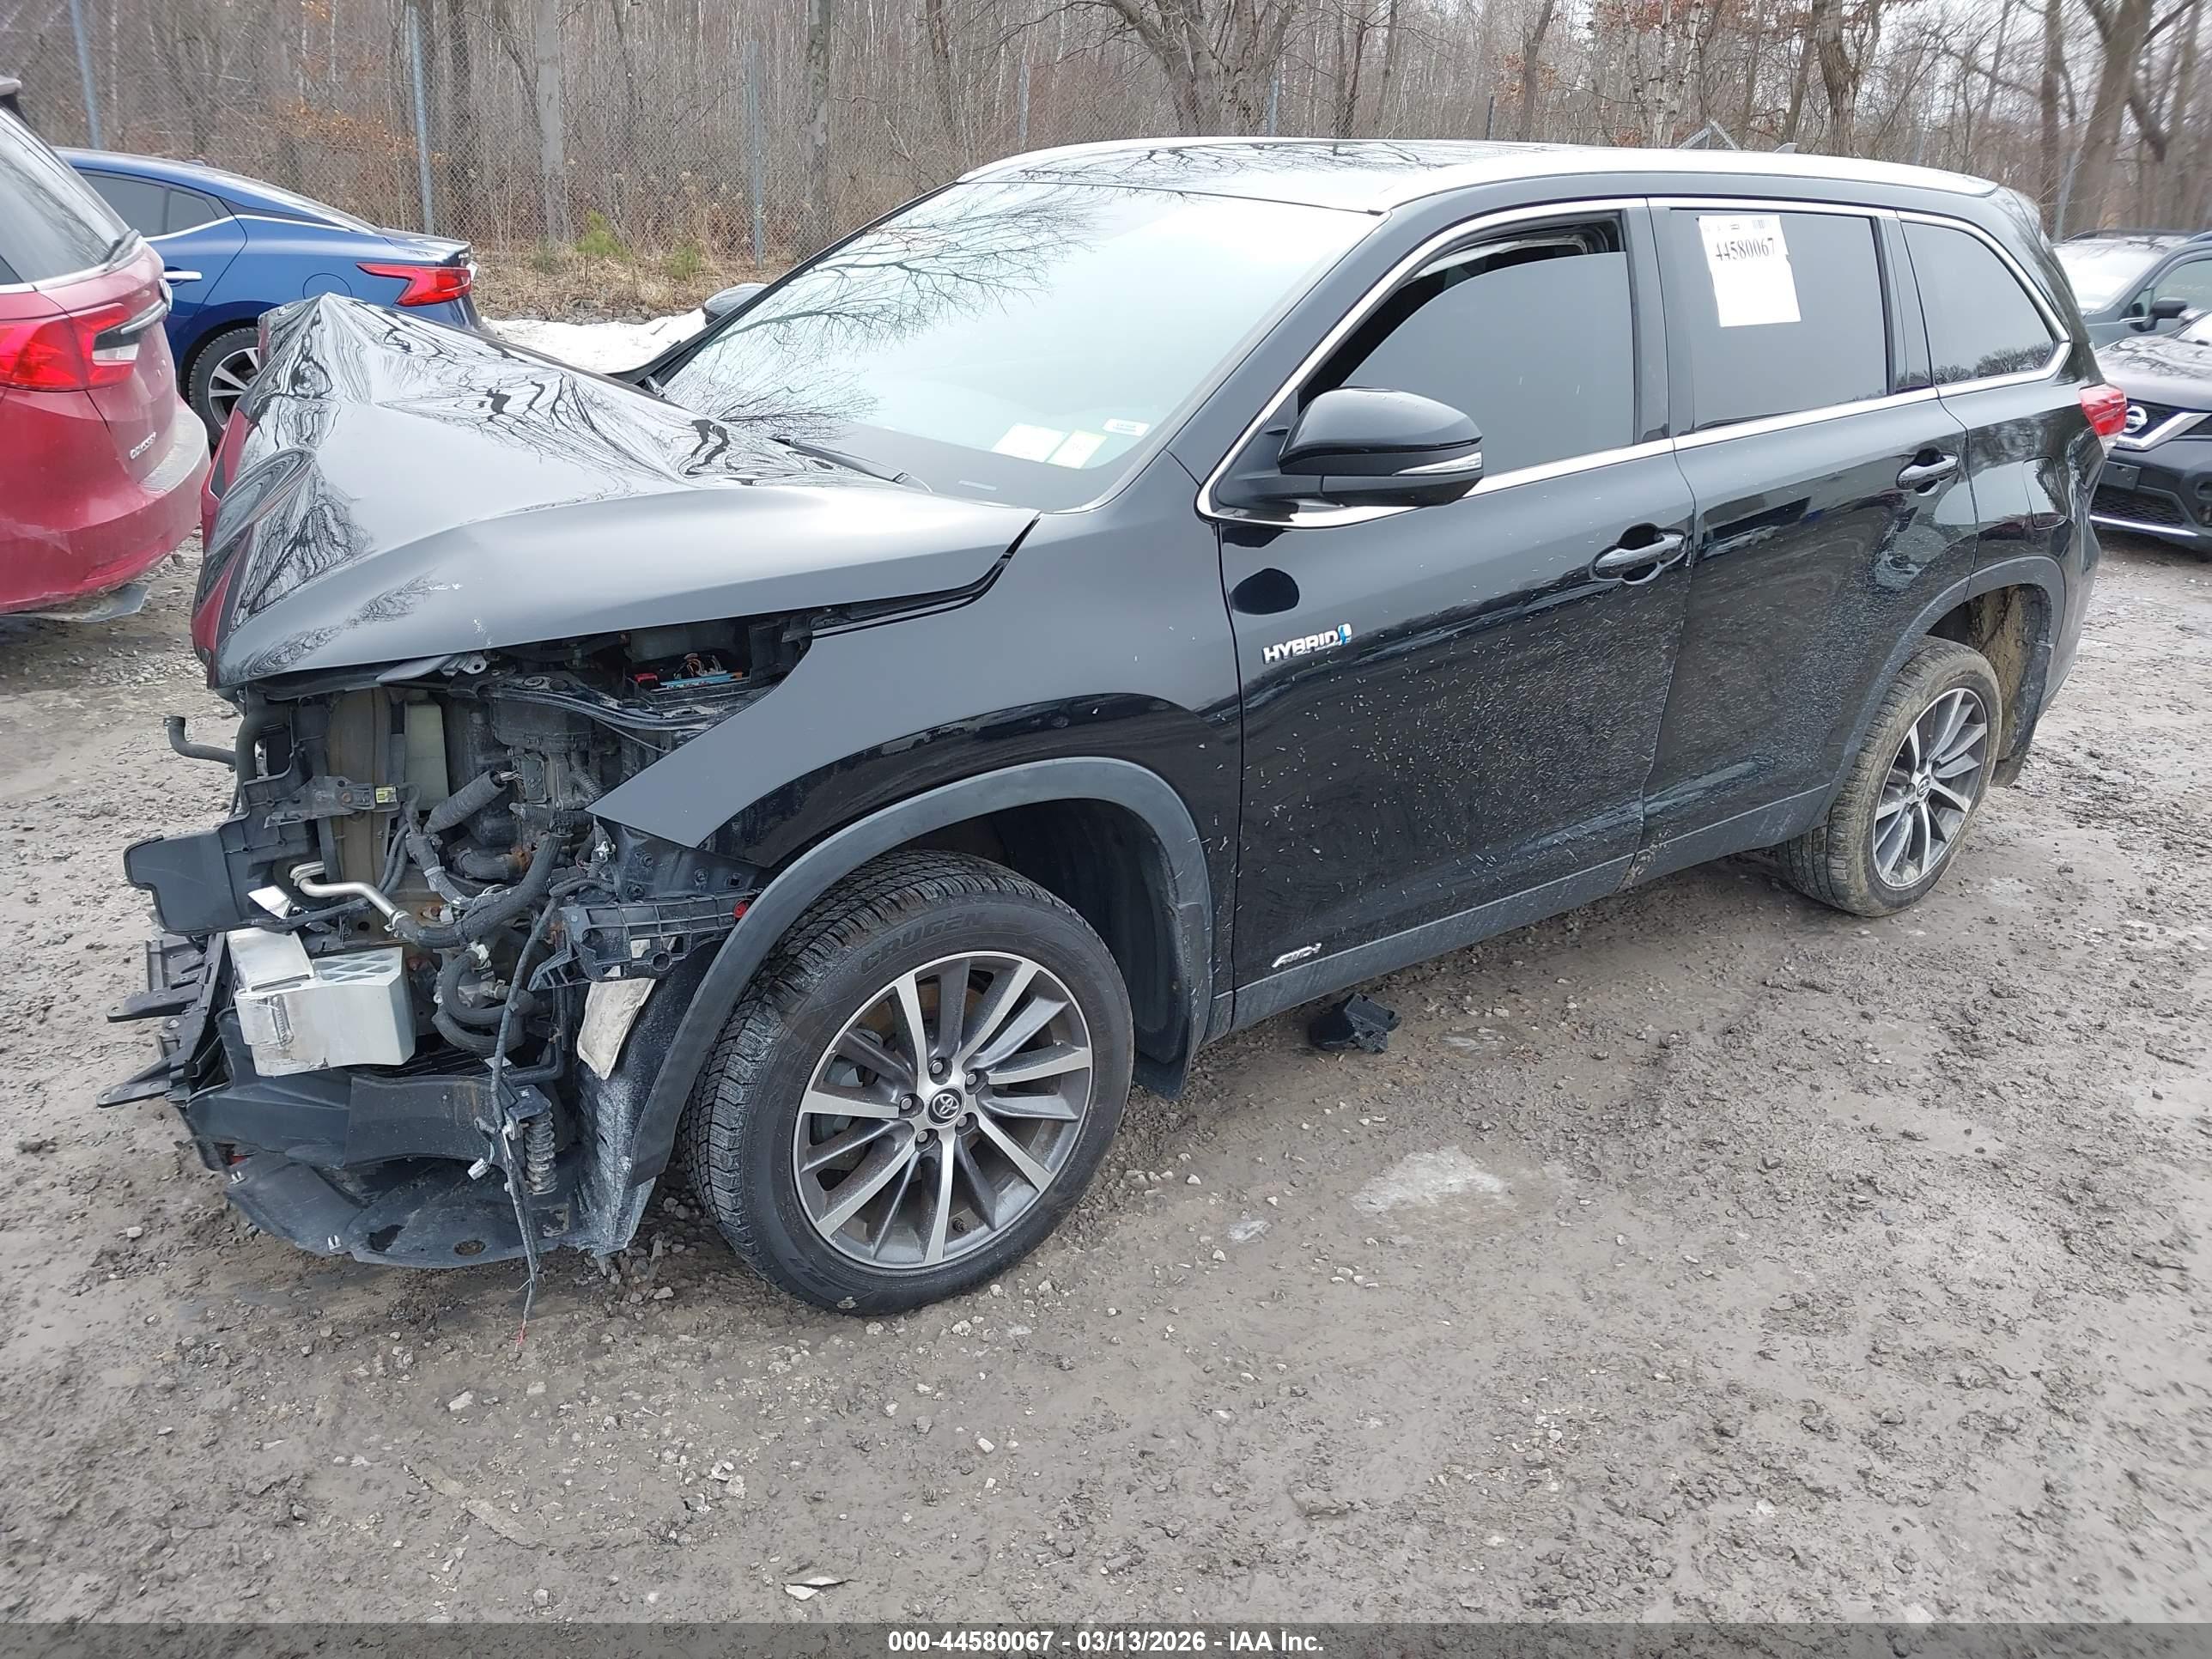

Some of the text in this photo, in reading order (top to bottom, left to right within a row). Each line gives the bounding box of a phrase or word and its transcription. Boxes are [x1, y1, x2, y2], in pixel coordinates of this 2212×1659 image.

[1716, 238, 1775, 261] 44580067
[1262, 629, 1339, 664] HYBRID
[860, 913, 987, 975] CRUGEN
